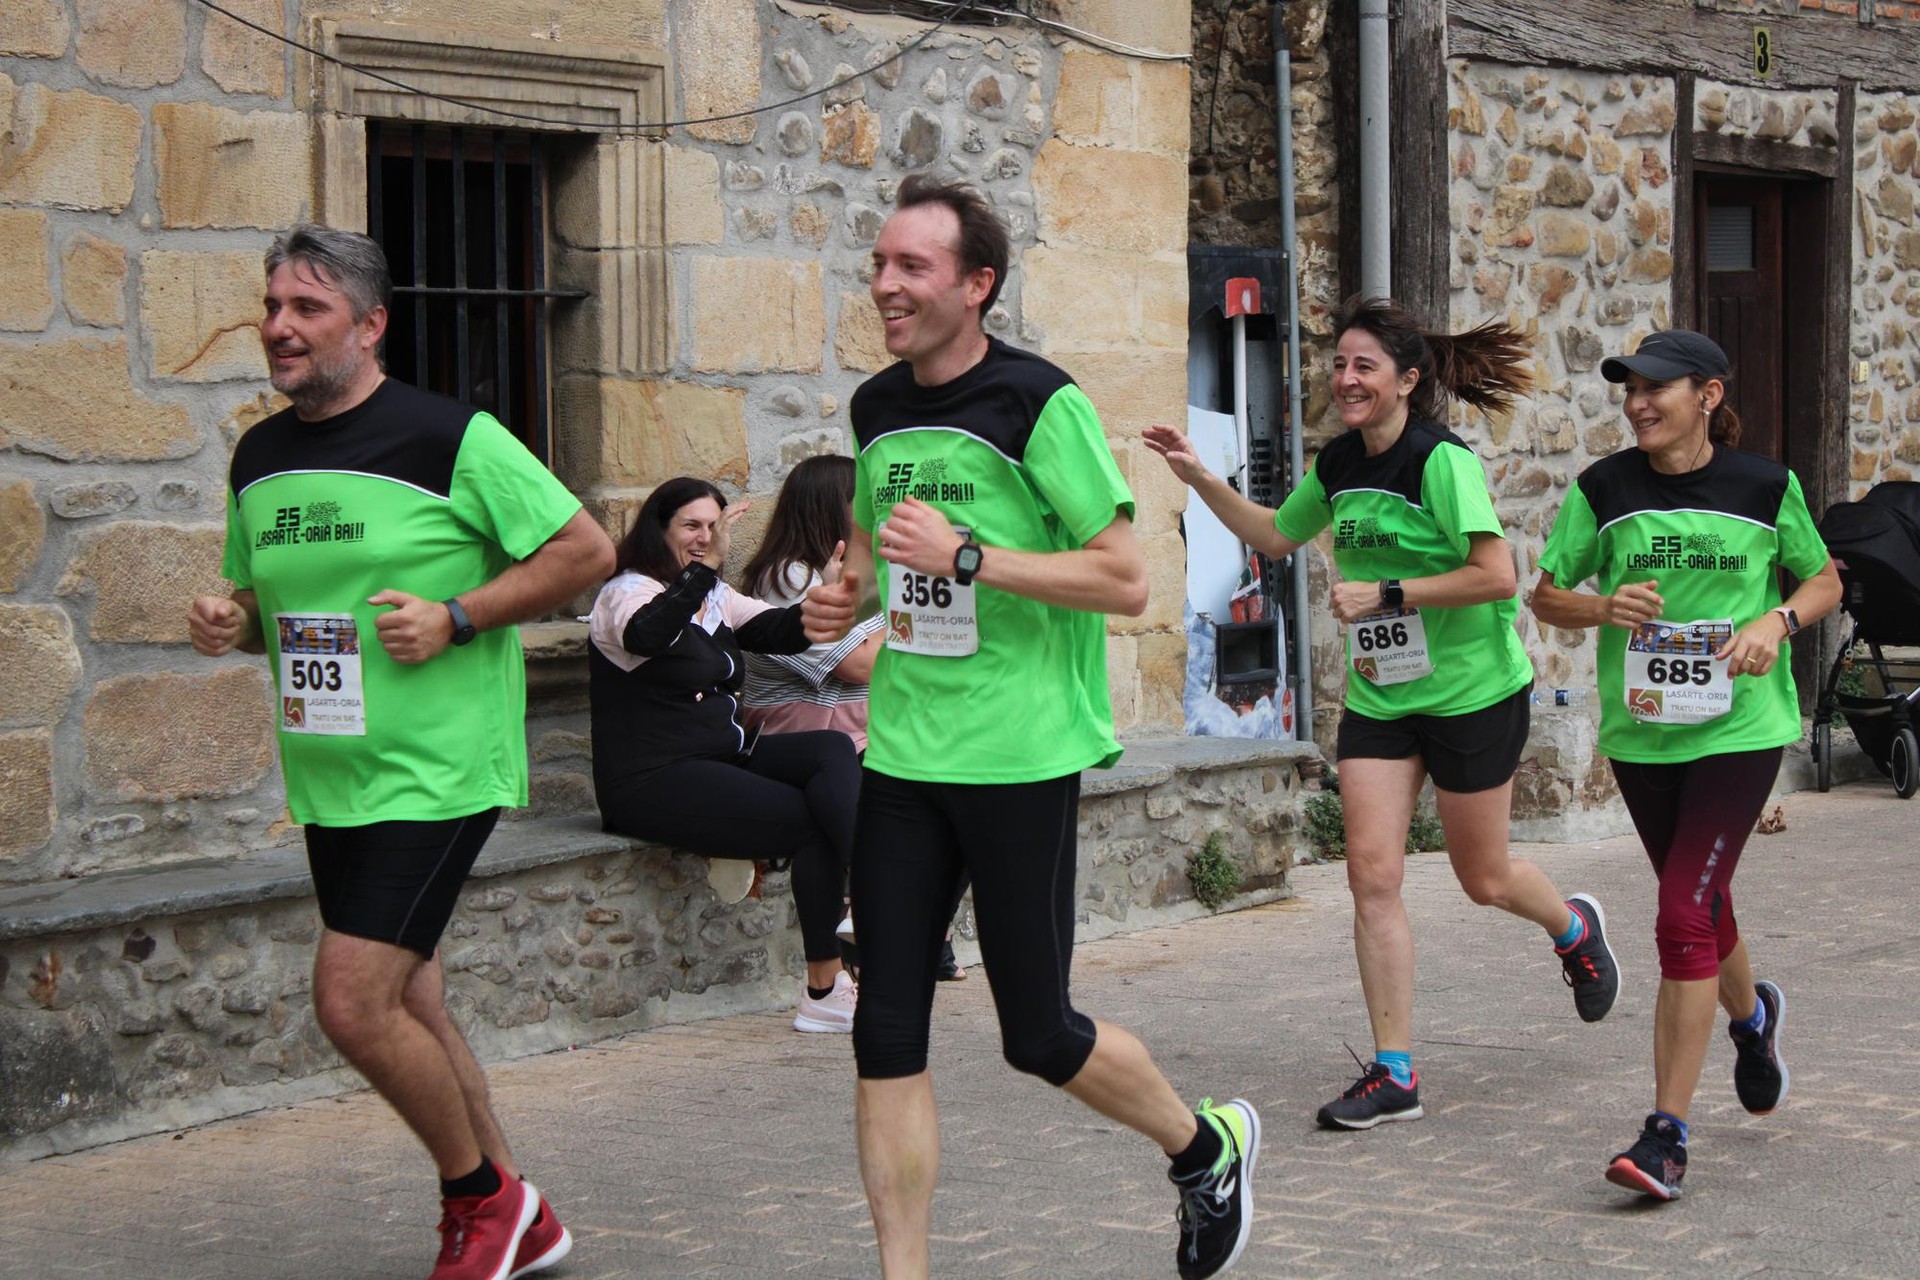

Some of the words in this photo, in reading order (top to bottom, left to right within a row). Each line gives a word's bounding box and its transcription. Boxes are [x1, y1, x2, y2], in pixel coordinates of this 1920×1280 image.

[1757, 31, 1769, 74] 3
[888, 463, 915, 484] 25
[275, 507, 300, 528] 25
[1339, 519, 1357, 536] 25
[1651, 536, 1681, 554] 25
[901, 572, 952, 609] 356
[913, 614, 975, 626] LASARTE-ORIA
[1357, 622, 1408, 652] 686
[1376, 649, 1426, 662] LASARTE-ORIA
[292, 660, 342, 691] 503
[1647, 658, 1712, 686] 685
[306, 698, 361, 707] LASARTE-ORIA
[1666, 690, 1728, 701] LASARTE-ORIA
